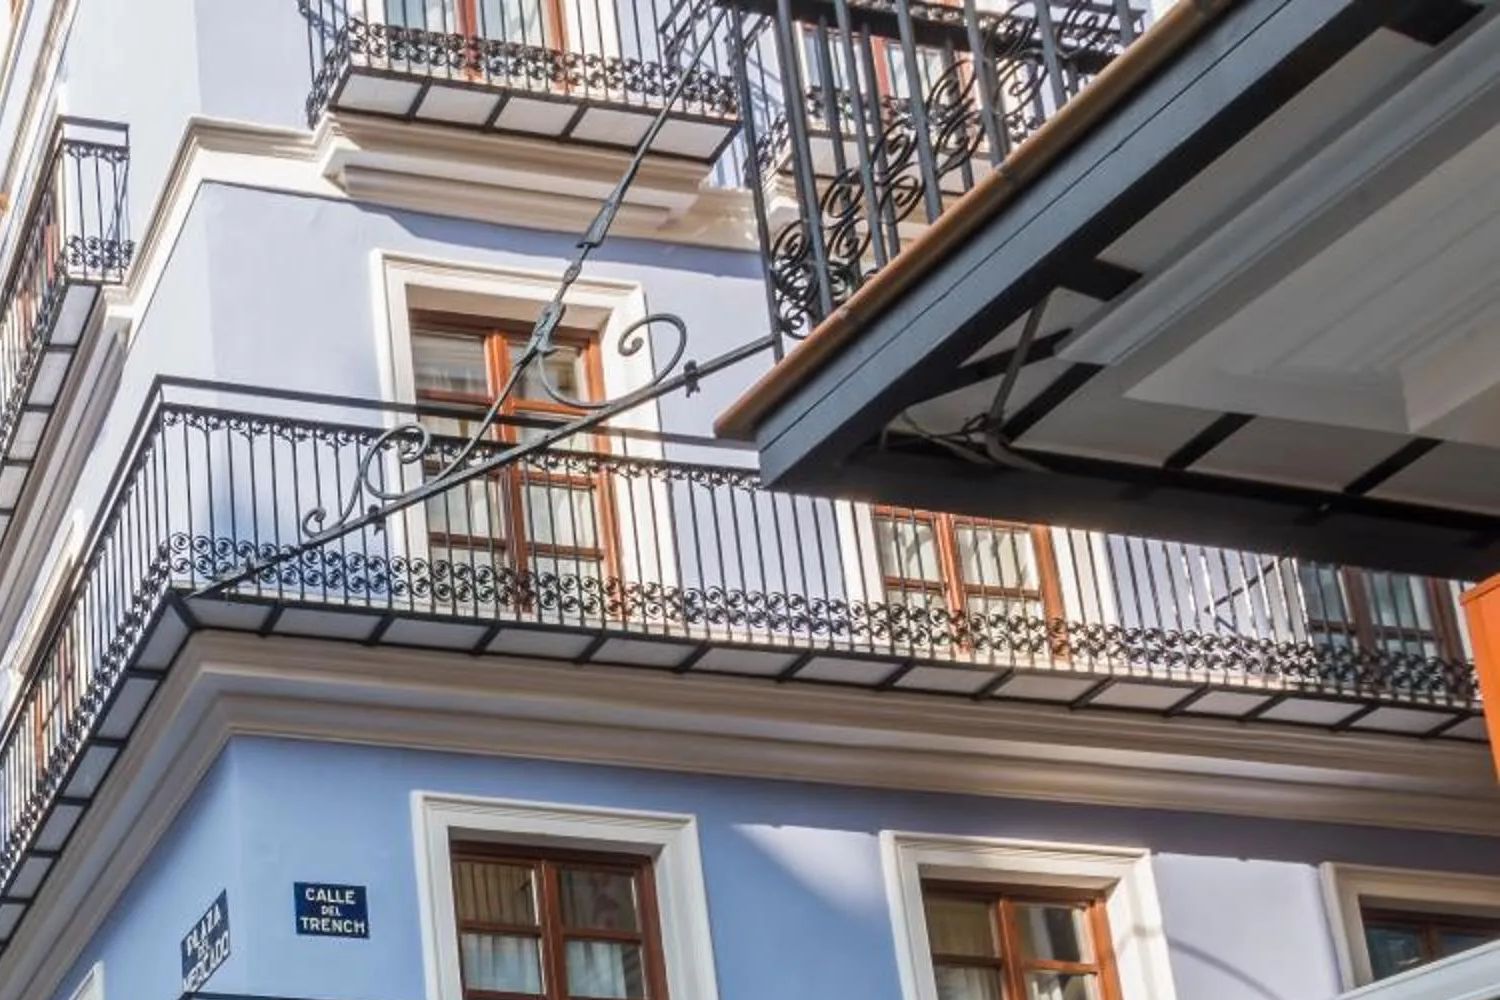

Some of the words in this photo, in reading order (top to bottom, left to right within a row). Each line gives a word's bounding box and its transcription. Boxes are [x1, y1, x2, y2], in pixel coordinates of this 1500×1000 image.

[305, 887, 356, 905] CALLE
[321, 905, 341, 917] DEL
[186, 904, 222, 957] PLAZA
[300, 916, 365, 934] TRENCH
[183, 930, 230, 992] MERCADO
